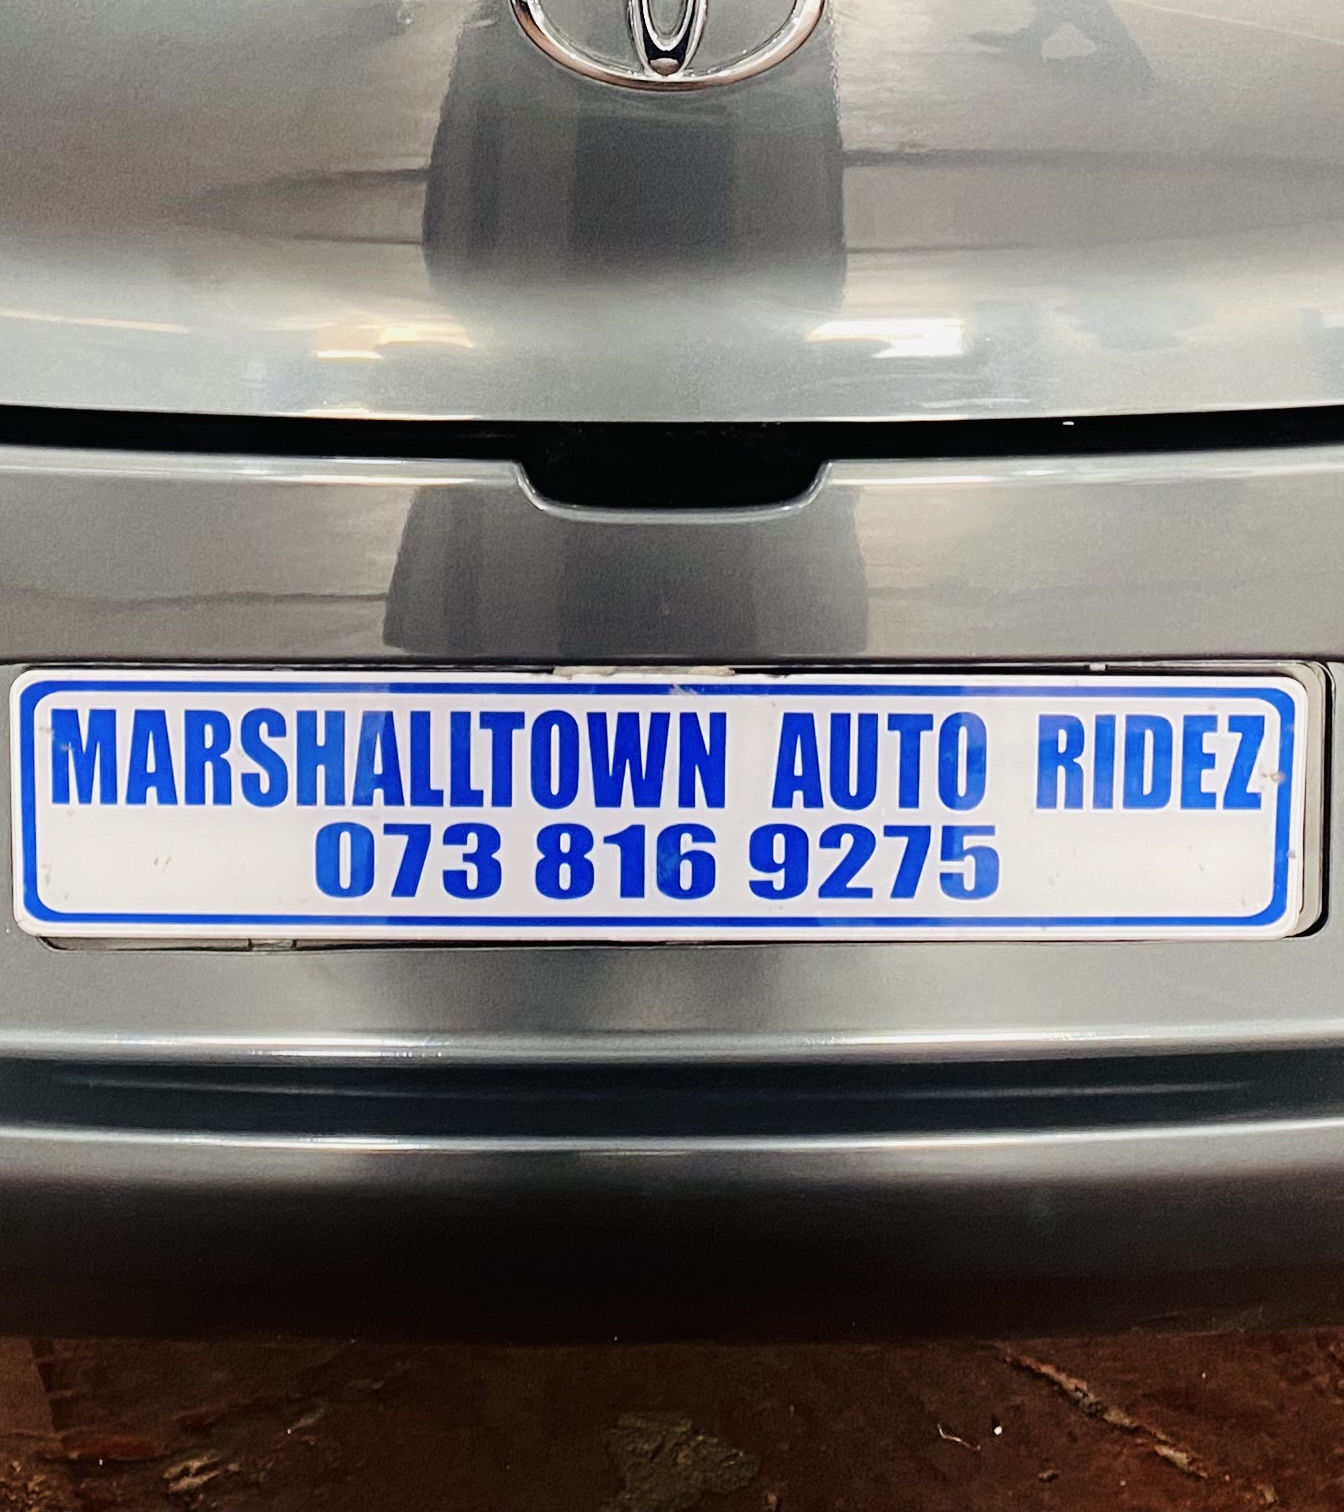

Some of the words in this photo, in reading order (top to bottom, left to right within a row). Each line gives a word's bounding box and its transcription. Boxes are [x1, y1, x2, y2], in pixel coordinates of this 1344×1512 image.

[50, 707, 727, 810] MARSHALLTOWN
[771, 711, 988, 811] AUTO
[1035, 713, 1266, 810] RIDEZ
[314, 821, 503, 900] 073
[534, 822, 716, 900] 816
[748, 823, 1000, 900] 9275
